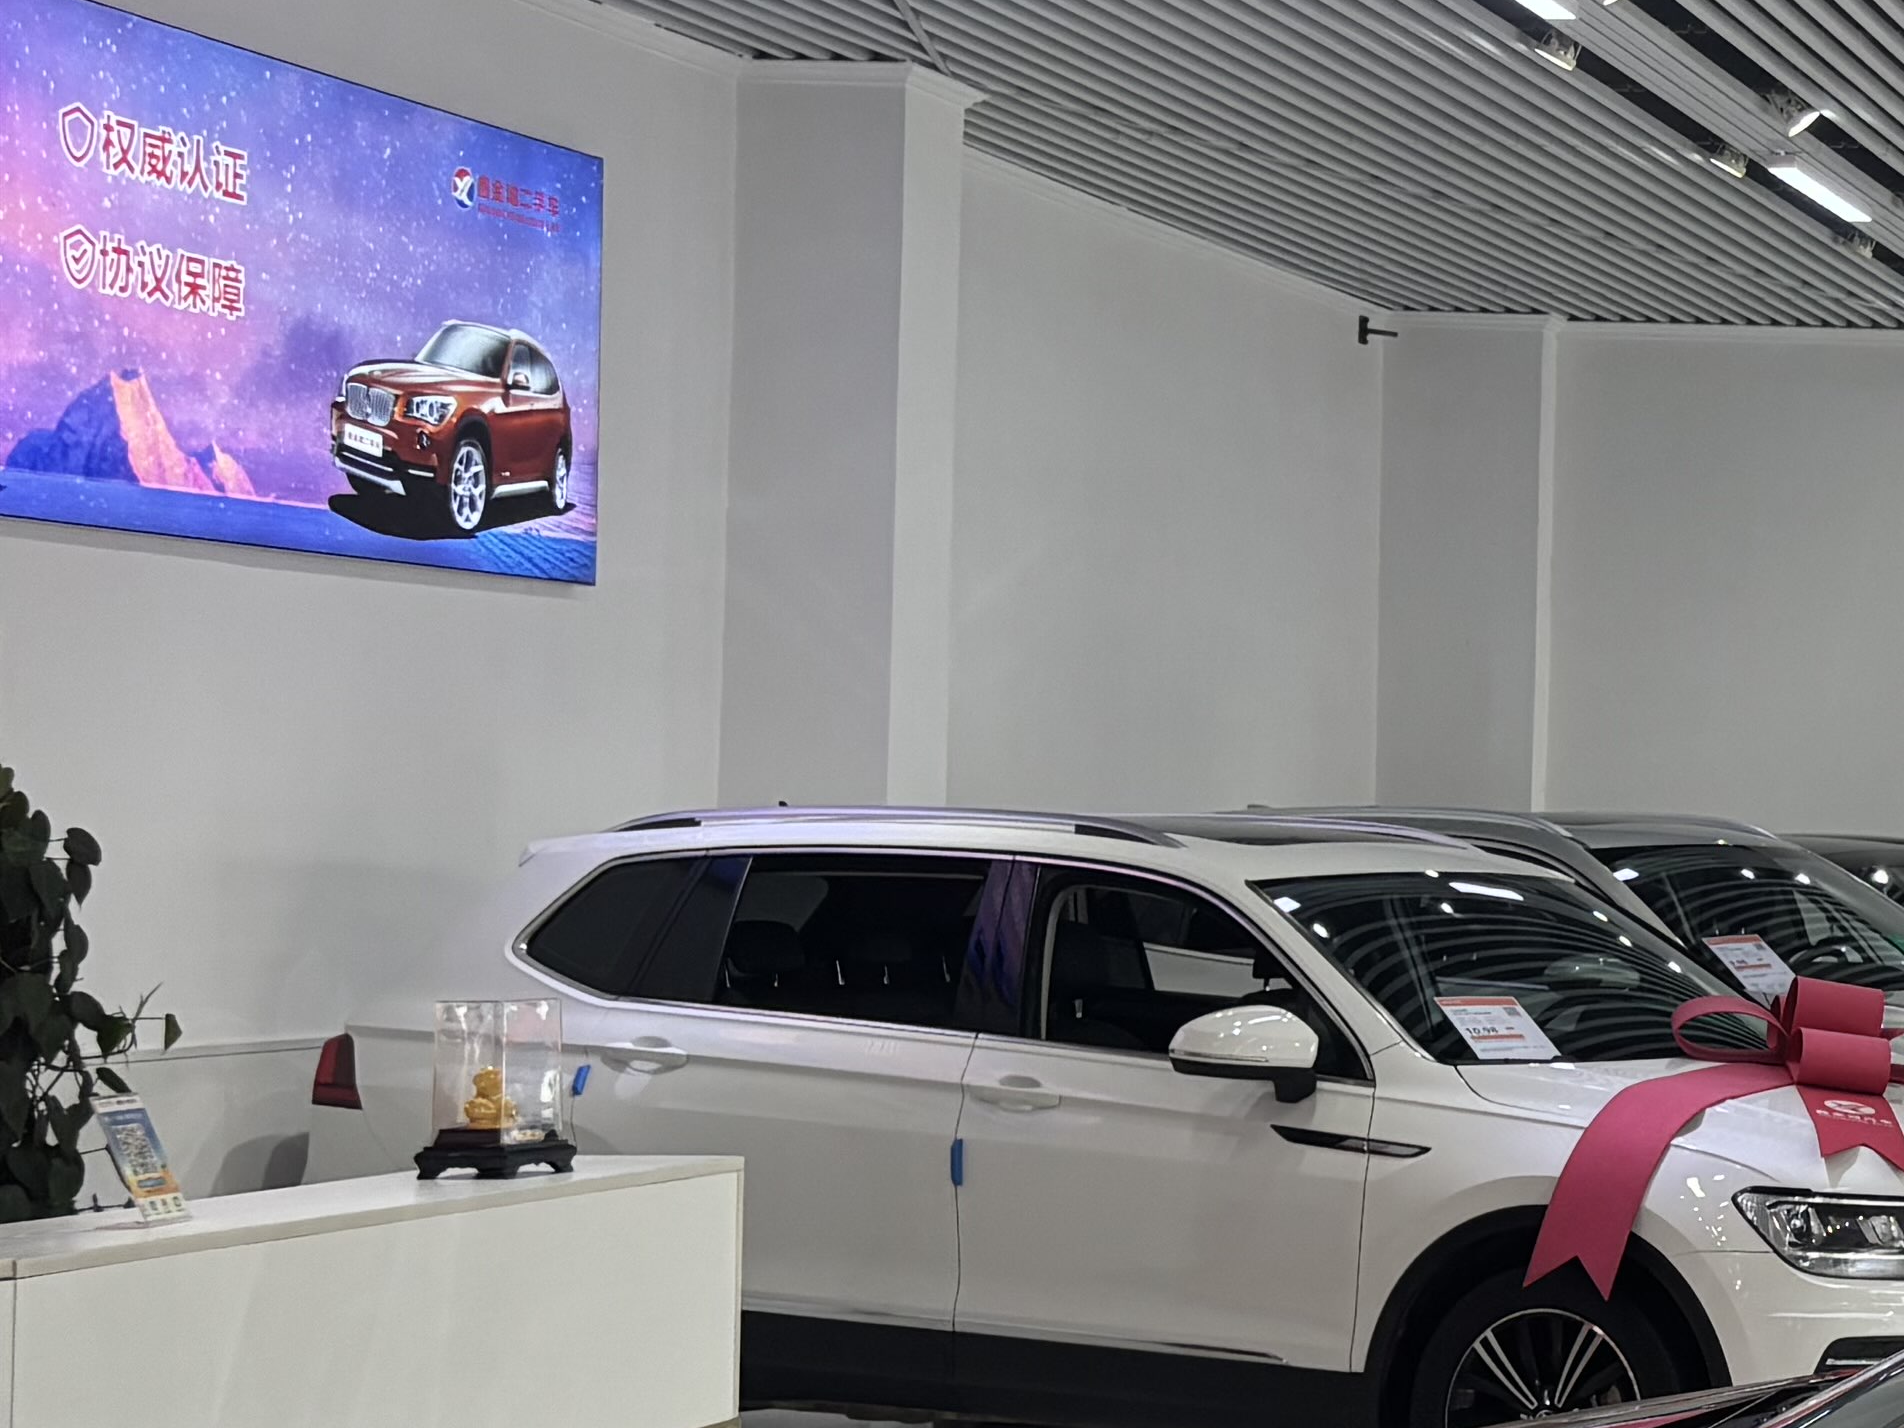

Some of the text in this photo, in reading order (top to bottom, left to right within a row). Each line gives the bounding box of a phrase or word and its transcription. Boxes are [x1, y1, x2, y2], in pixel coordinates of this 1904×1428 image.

[101, 110, 248, 205] 权威认证
[98, 232, 245, 320] 协议保障
